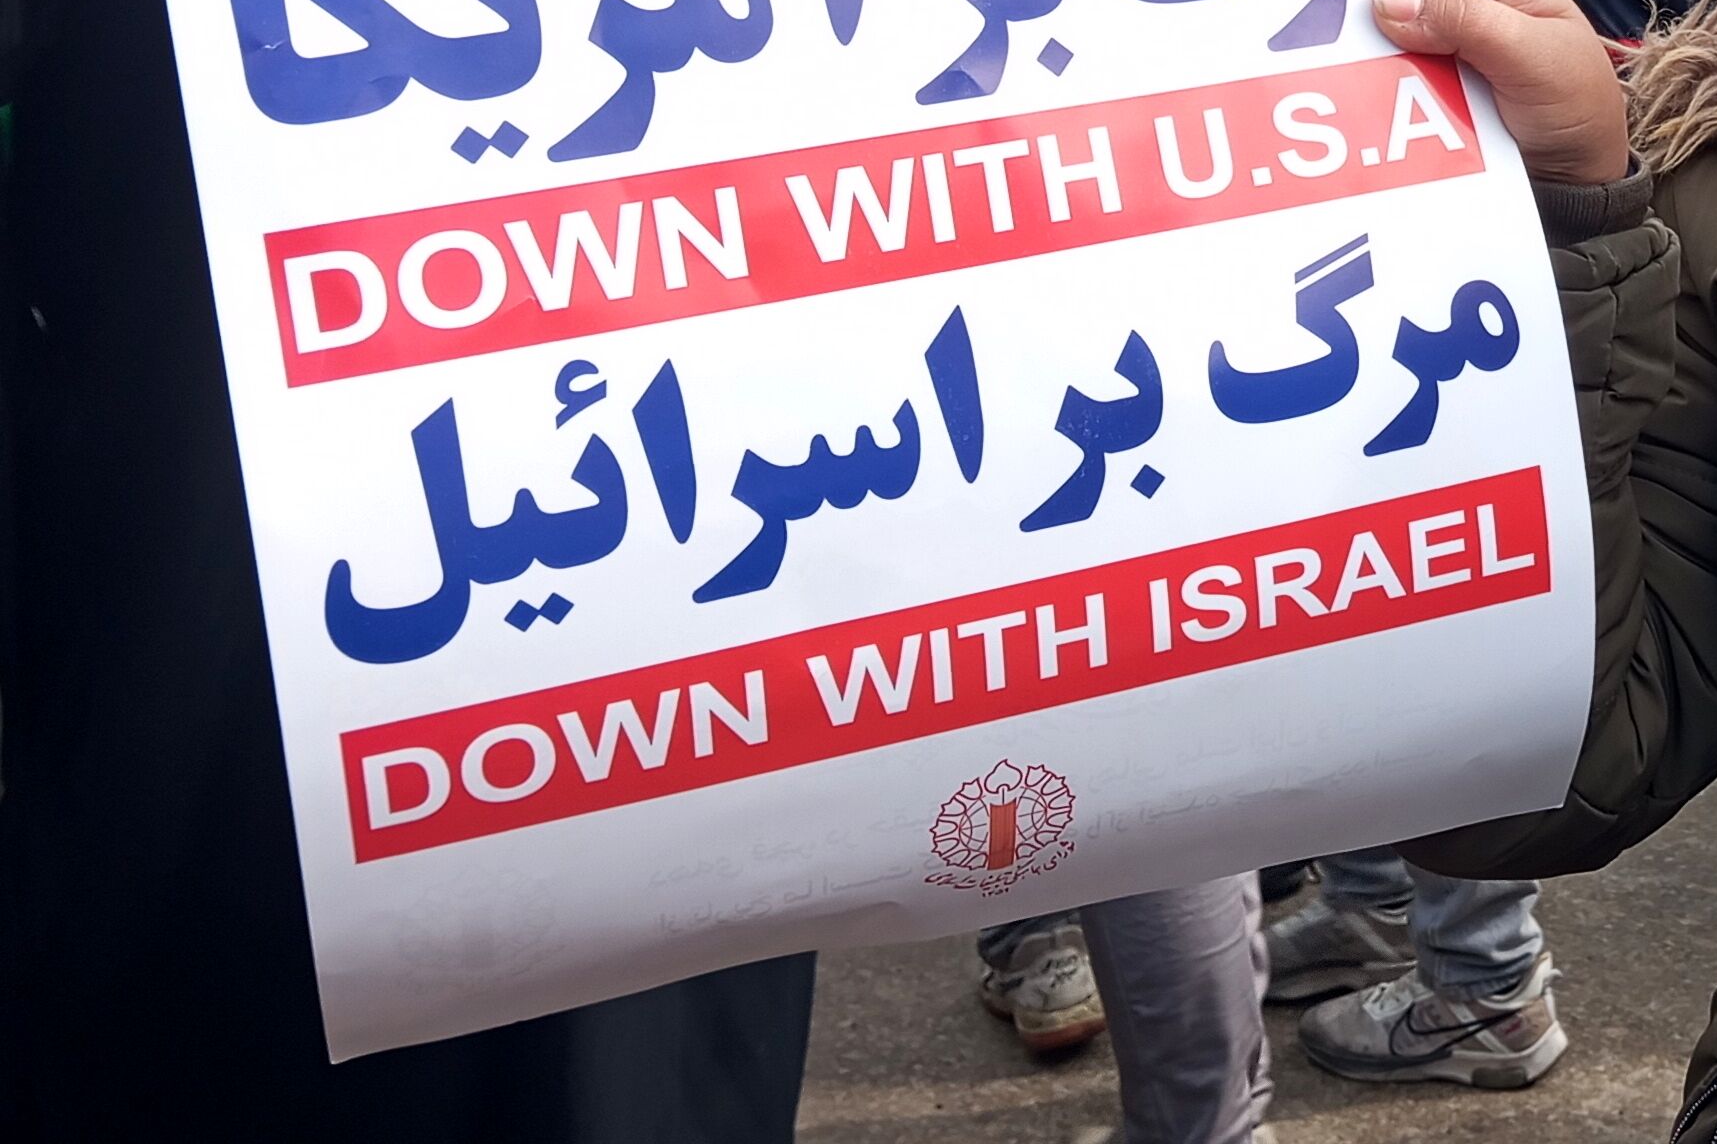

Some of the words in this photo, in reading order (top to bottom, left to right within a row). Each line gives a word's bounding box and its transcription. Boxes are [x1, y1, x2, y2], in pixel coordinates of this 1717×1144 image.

[283, 185, 749, 354] DOWN
[784, 125, 1123, 263] WITH
[1154, 75, 1466, 199] U.S.A
[1208, 232, 1520, 457] مرگ
[325, 304, 984, 665] اسرائیل
[1019, 329, 1165, 532] بر
[361, 669, 769, 831] DOWN
[806, 592, 1108, 728] WITH
[1148, 503, 1535, 654] ISRAEL
